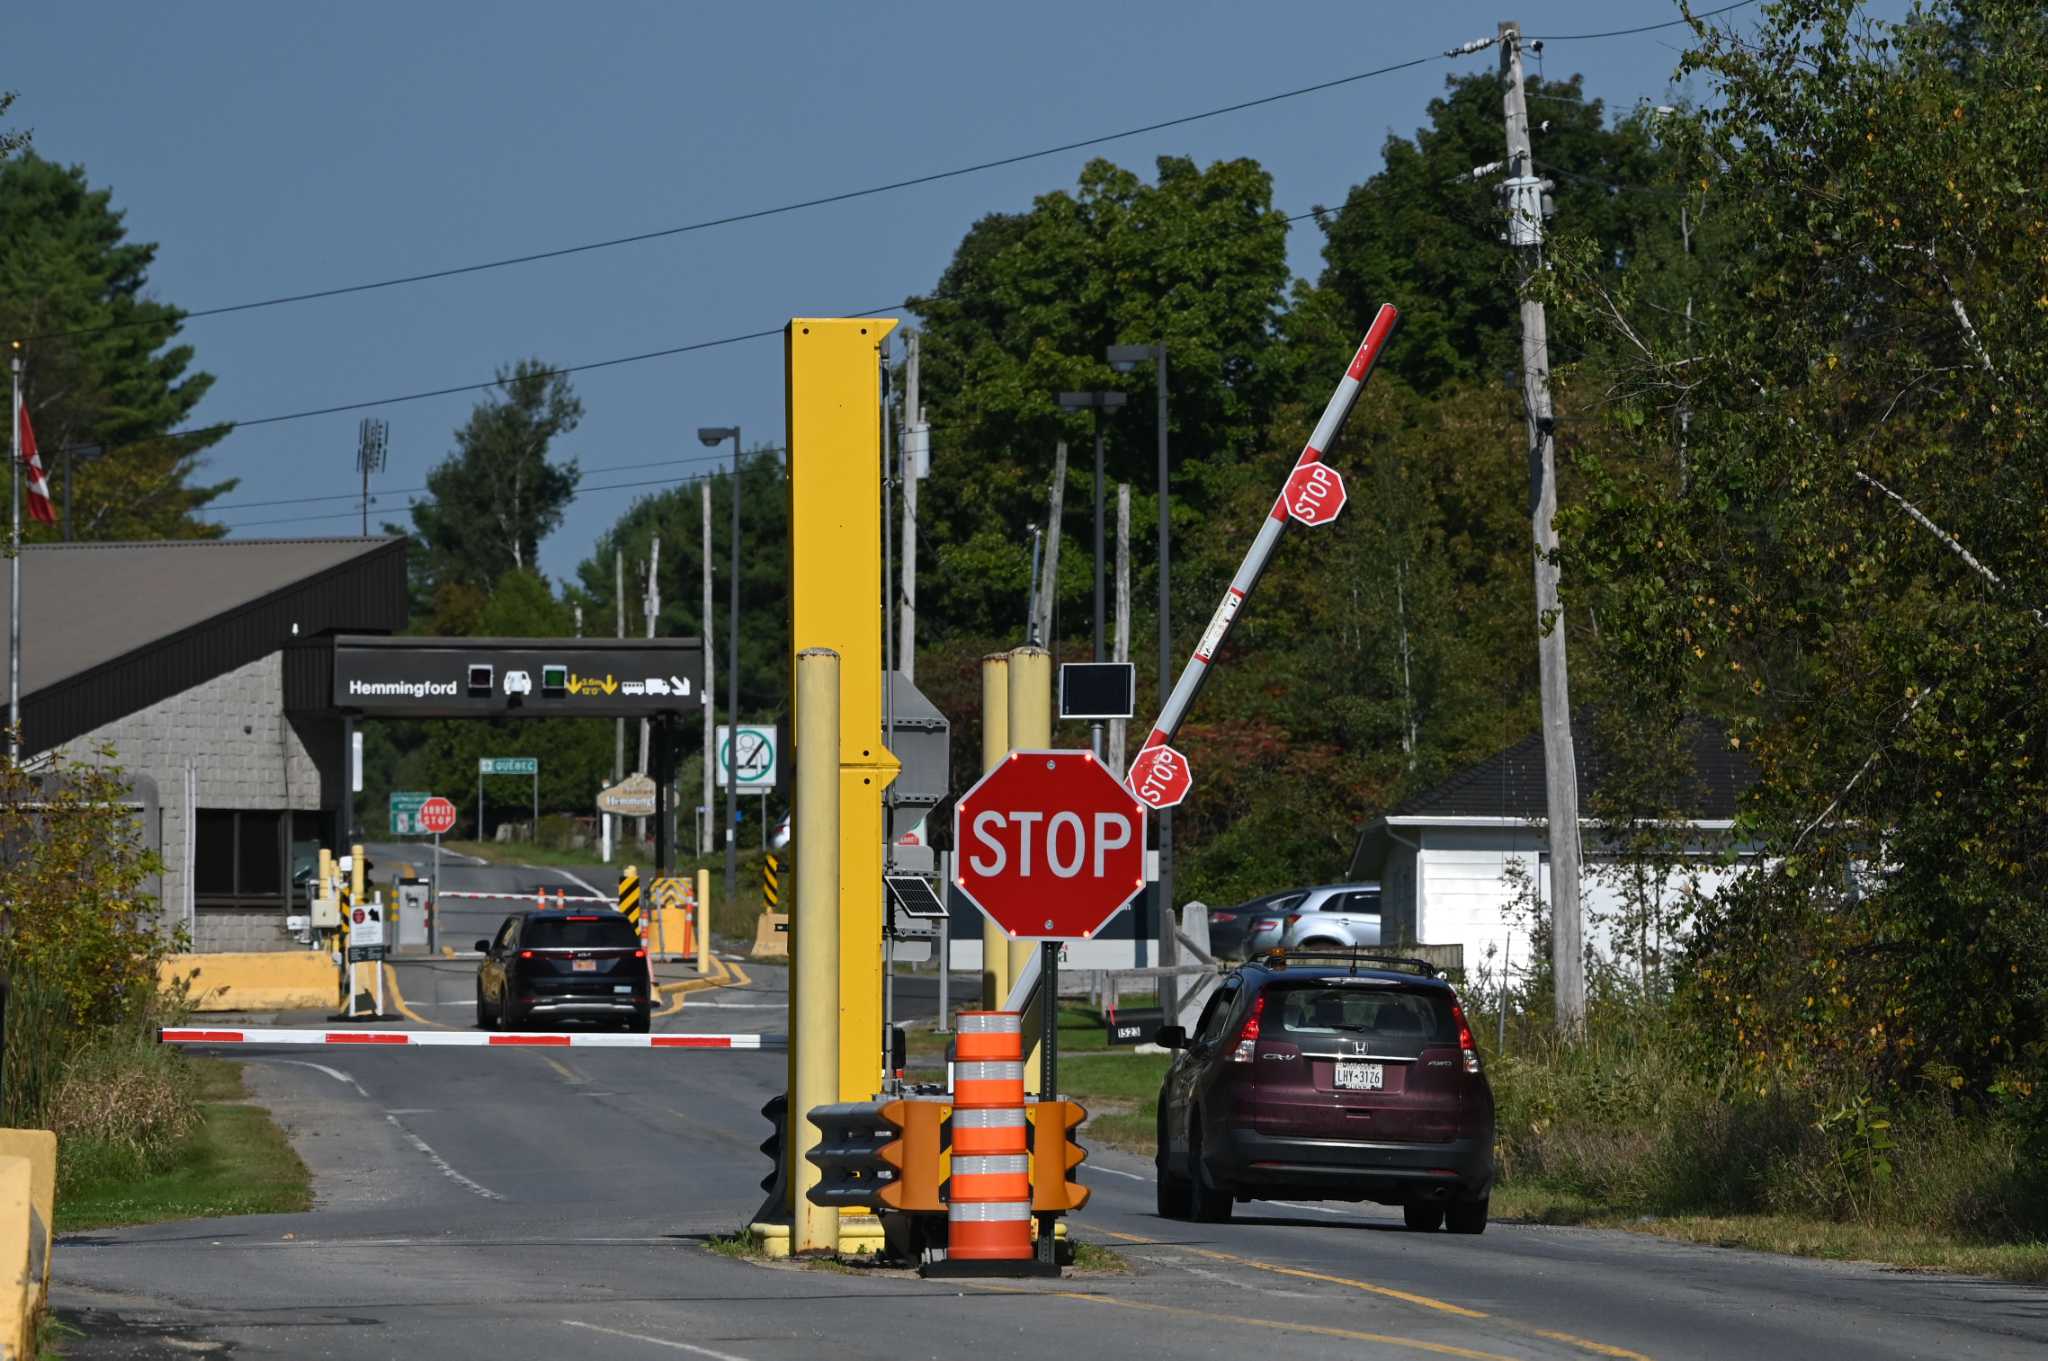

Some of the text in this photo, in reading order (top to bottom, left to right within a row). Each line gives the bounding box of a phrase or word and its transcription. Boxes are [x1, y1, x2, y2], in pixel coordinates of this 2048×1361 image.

[1294, 467, 1333, 520] STOP
[349, 679, 458, 698] Hemmingford
[1140, 748, 1179, 803] STOP
[423, 815, 452, 825] STOP
[969, 809, 1132, 879] STOP
[1426, 1059, 1452, 1067] AWD
